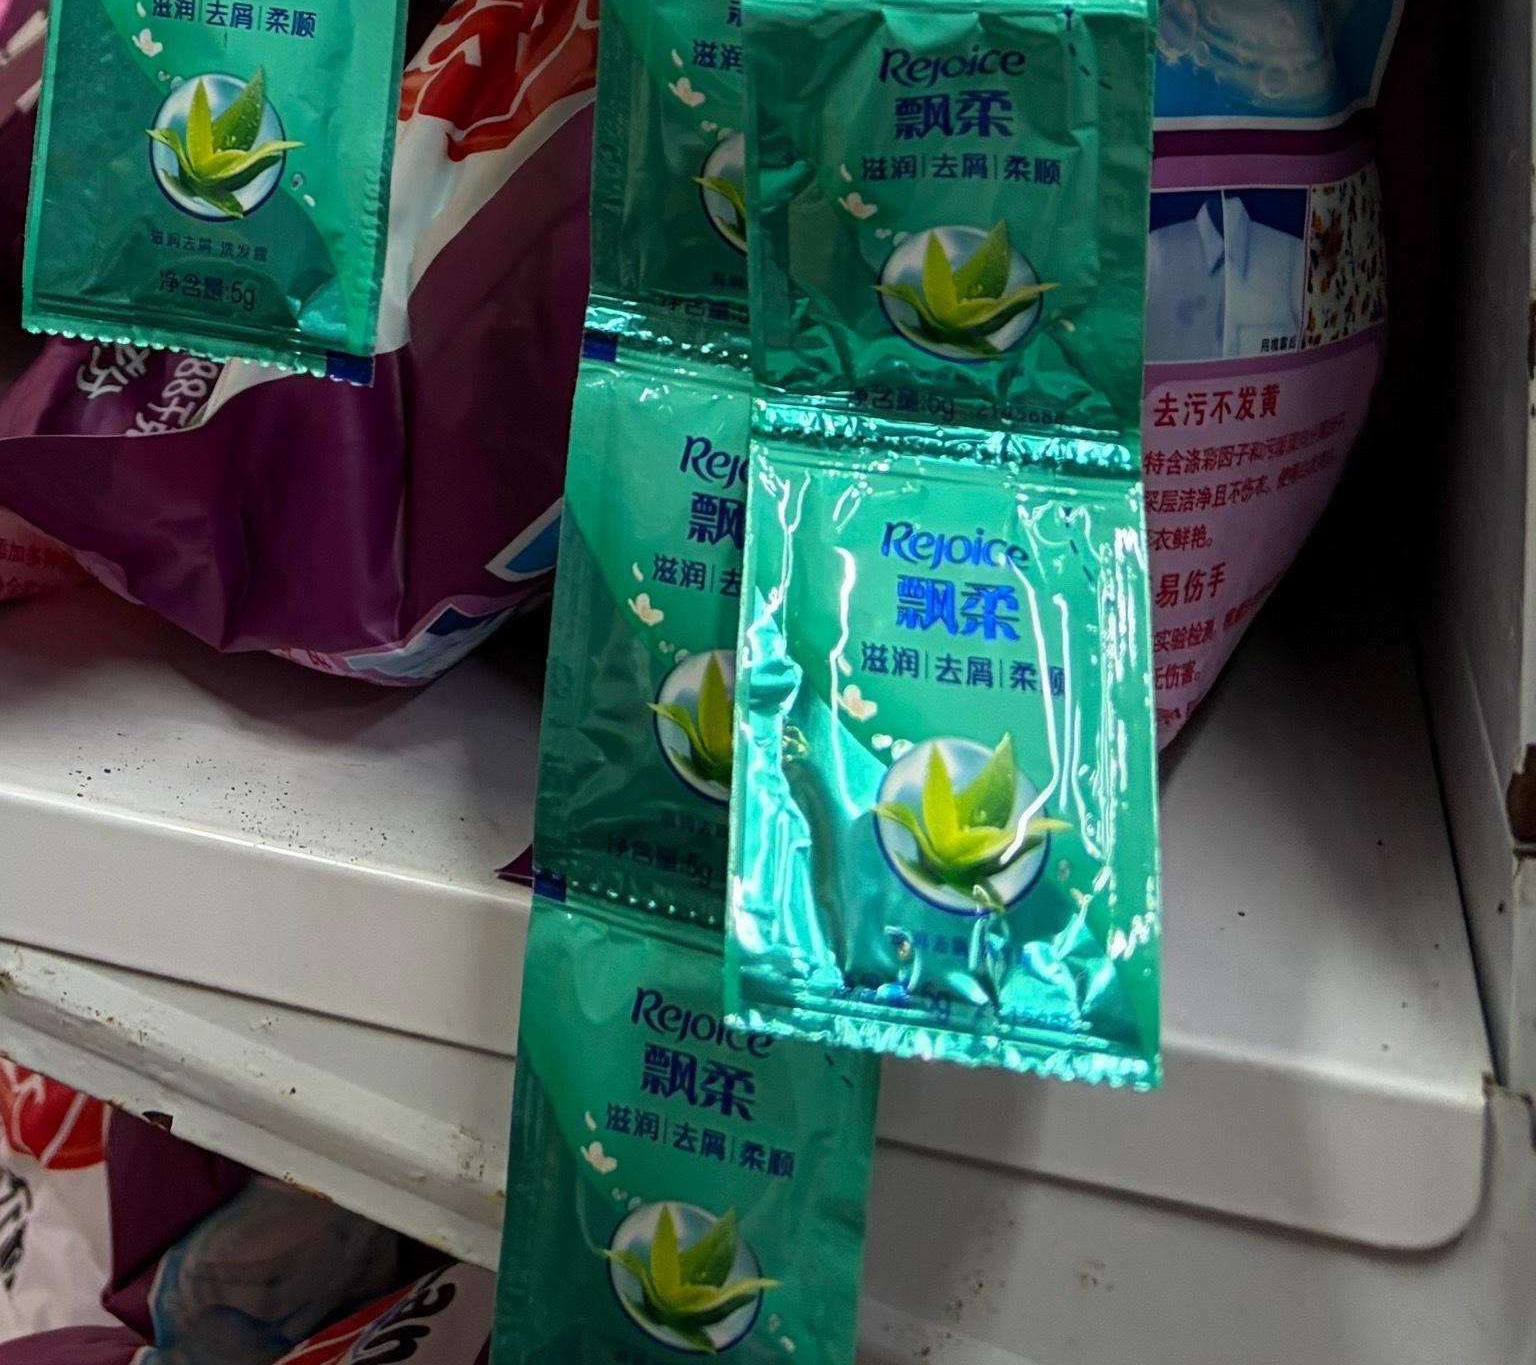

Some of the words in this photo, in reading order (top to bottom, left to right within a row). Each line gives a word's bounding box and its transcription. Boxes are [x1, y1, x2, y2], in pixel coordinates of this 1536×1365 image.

[879, 44, 1027, 87] Rejoice
[895, 90, 1014, 140] 飘柔
[158, 270, 257, 312] 净含量:5g
[1153, 383, 1281, 429] 去污不发黄
[1154, 562, 1227, 609] 易伤手
[631, 986, 774, 1060] Rejoice
